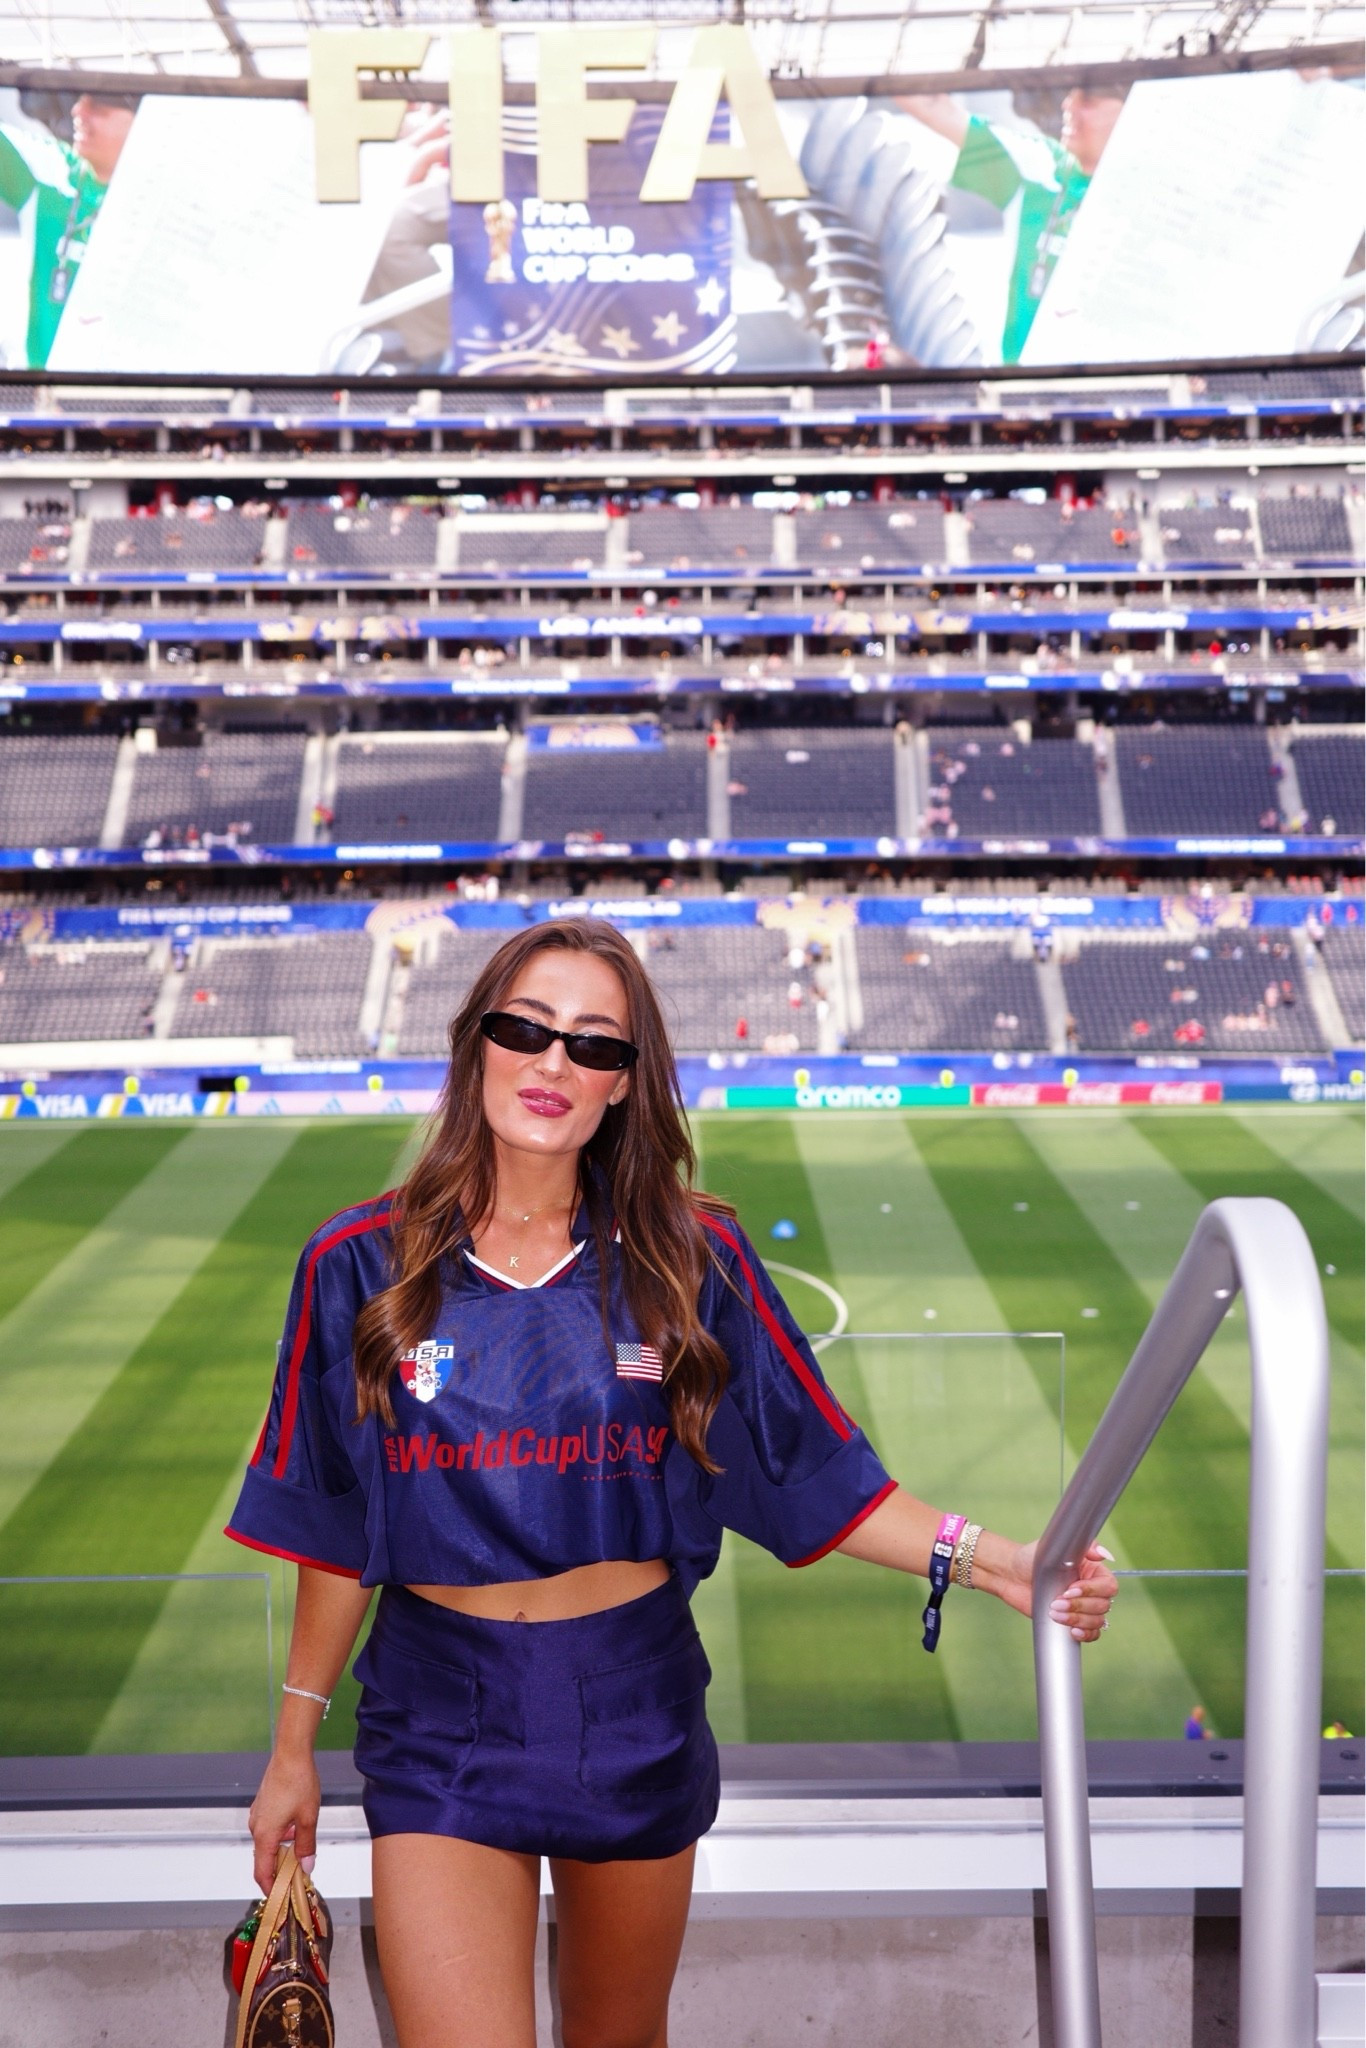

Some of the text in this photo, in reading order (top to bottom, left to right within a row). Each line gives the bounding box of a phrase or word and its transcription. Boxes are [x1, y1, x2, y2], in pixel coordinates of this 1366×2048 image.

[307, 26, 809, 203] FIFA
[521, 226, 635, 254] WORLD
[522, 255, 586, 283] CUP
[538, 617, 590, 635] LOS
[118, 908, 151, 925] FIFA
[152, 908, 206, 924] WORLD
[207, 907, 237, 923] CUP
[548, 901, 590, 916] LOS
[36, 1095, 88, 1117] VISA
[140, 1093, 195, 1117] VISA
[796, 1085, 901, 1108] aramco
[509, 1256, 519, 1268] K
[384, 1437, 398, 1473] FIFA
